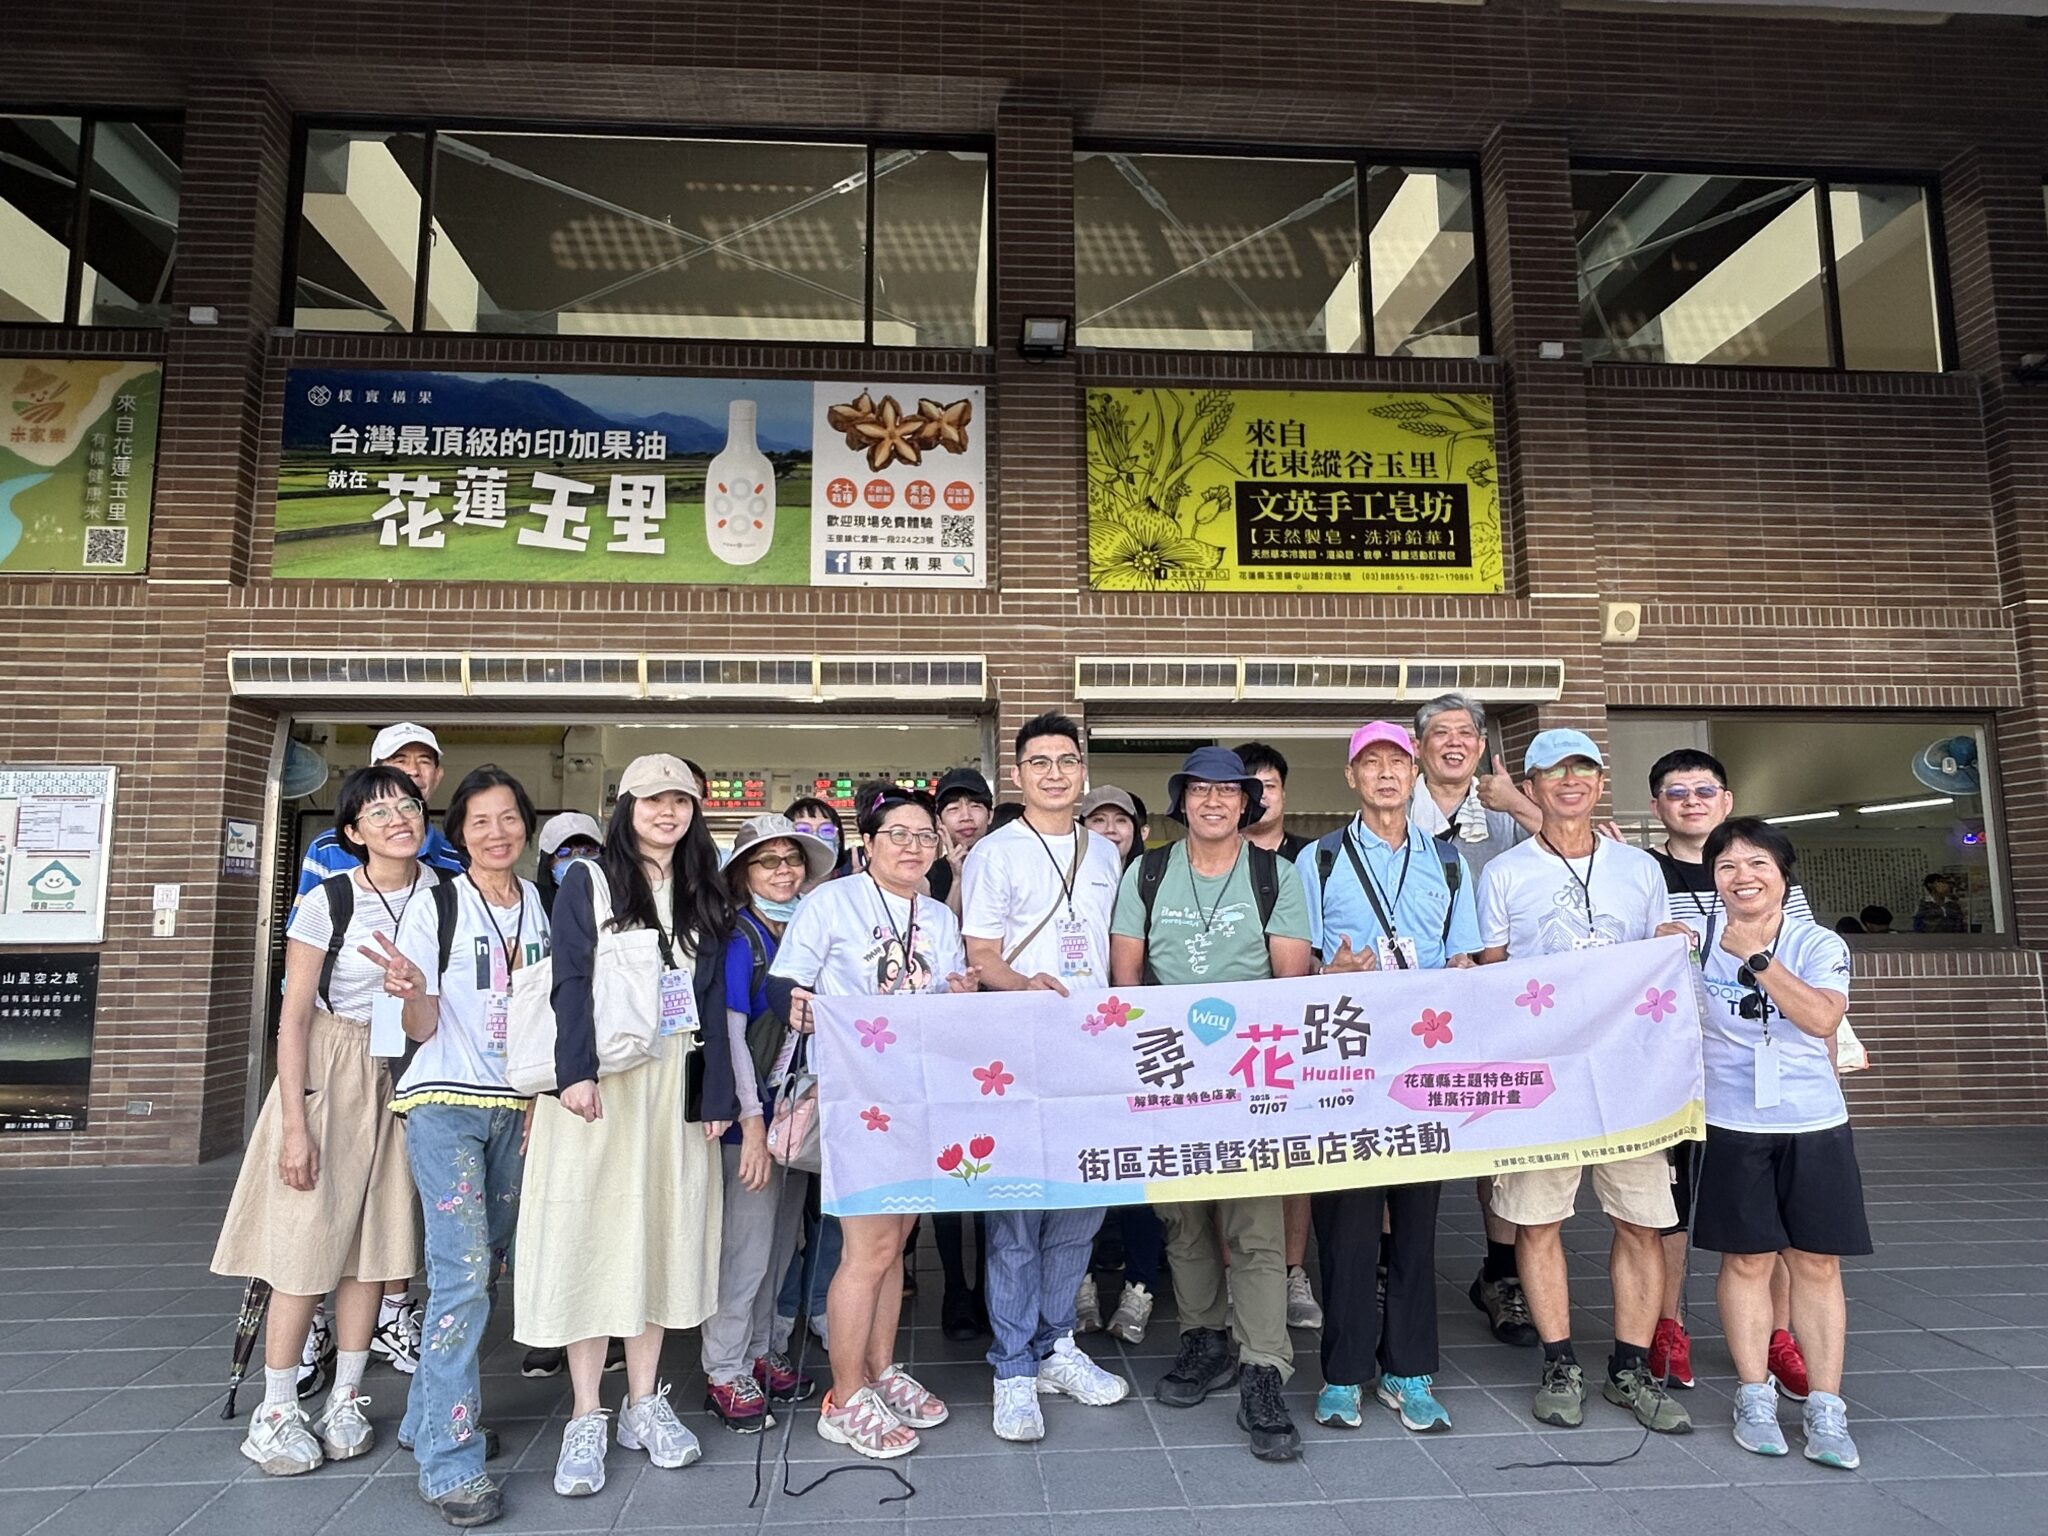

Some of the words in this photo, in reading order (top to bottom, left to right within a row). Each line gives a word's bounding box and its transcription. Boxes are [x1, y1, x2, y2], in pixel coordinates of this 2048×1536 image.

[329, 424, 667, 461] 台灣最頂級的印加果油
[1245, 419, 1307, 449] 來自
[107, 394, 137, 521] 來自花蓮玉里
[1246, 450, 1440, 481] 花東縱谷玉里
[84, 433, 107, 520] 有機健康米
[327, 470, 368, 489] 就在
[371, 467, 666, 555] 花蓮玉里
[1248, 488, 1454, 524] 文英手工皂坊
[827, 515, 933, 529] 歡迎現場免費體驗
[2, 971, 79, 985] 山星空之旅
[1192, 1008, 1230, 1032] Way
[1301, 1065, 1376, 1083] Hualien
[1404, 1070, 1545, 1088] 花蓮縣主題特色街區
[1133, 1088, 1238, 1108] 解鎖花蓮特色店家
[1249, 1101, 1288, 1115] 07/07
[1318, 1095, 1355, 1108] 11/09
[1427, 1090, 1522, 1107] 推廣行銷計畫
[1077, 1121, 1451, 1183] 街區走讀暨街區店家活動
